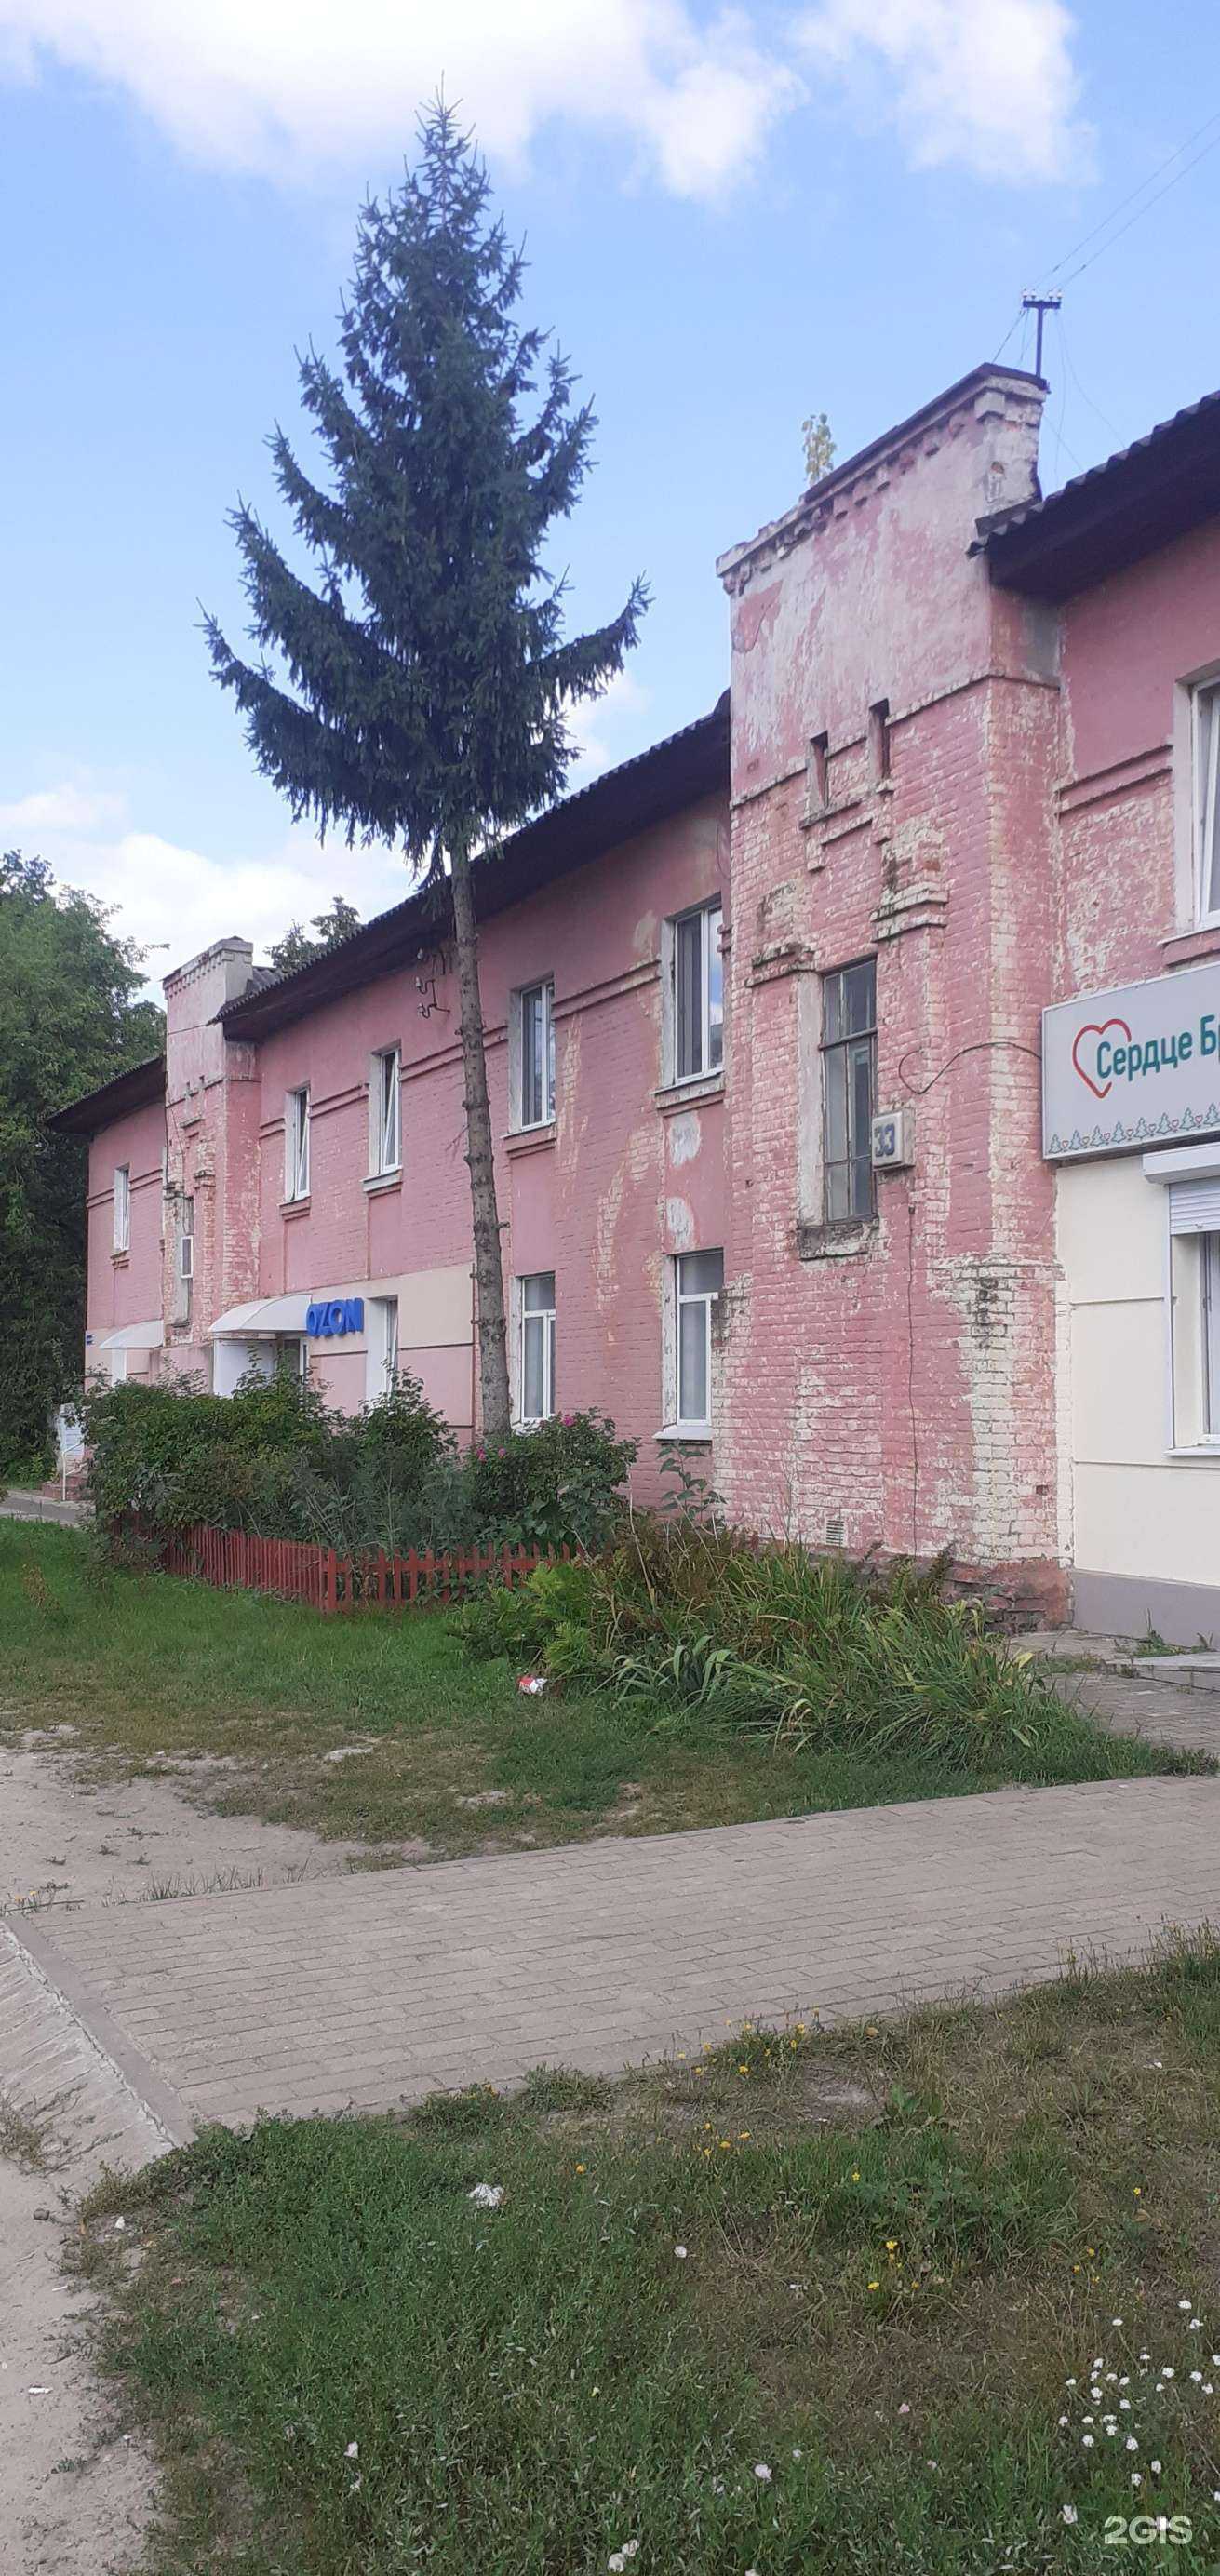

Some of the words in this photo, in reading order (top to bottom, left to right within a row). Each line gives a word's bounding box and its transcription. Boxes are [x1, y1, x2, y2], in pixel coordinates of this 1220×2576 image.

[1096, 1031, 1193, 1081] Сердце
[1200, 1014, 1220, 1064] Б
[874, 1123, 895, 1158] 33
[306, 1297, 365, 1337] OZON
